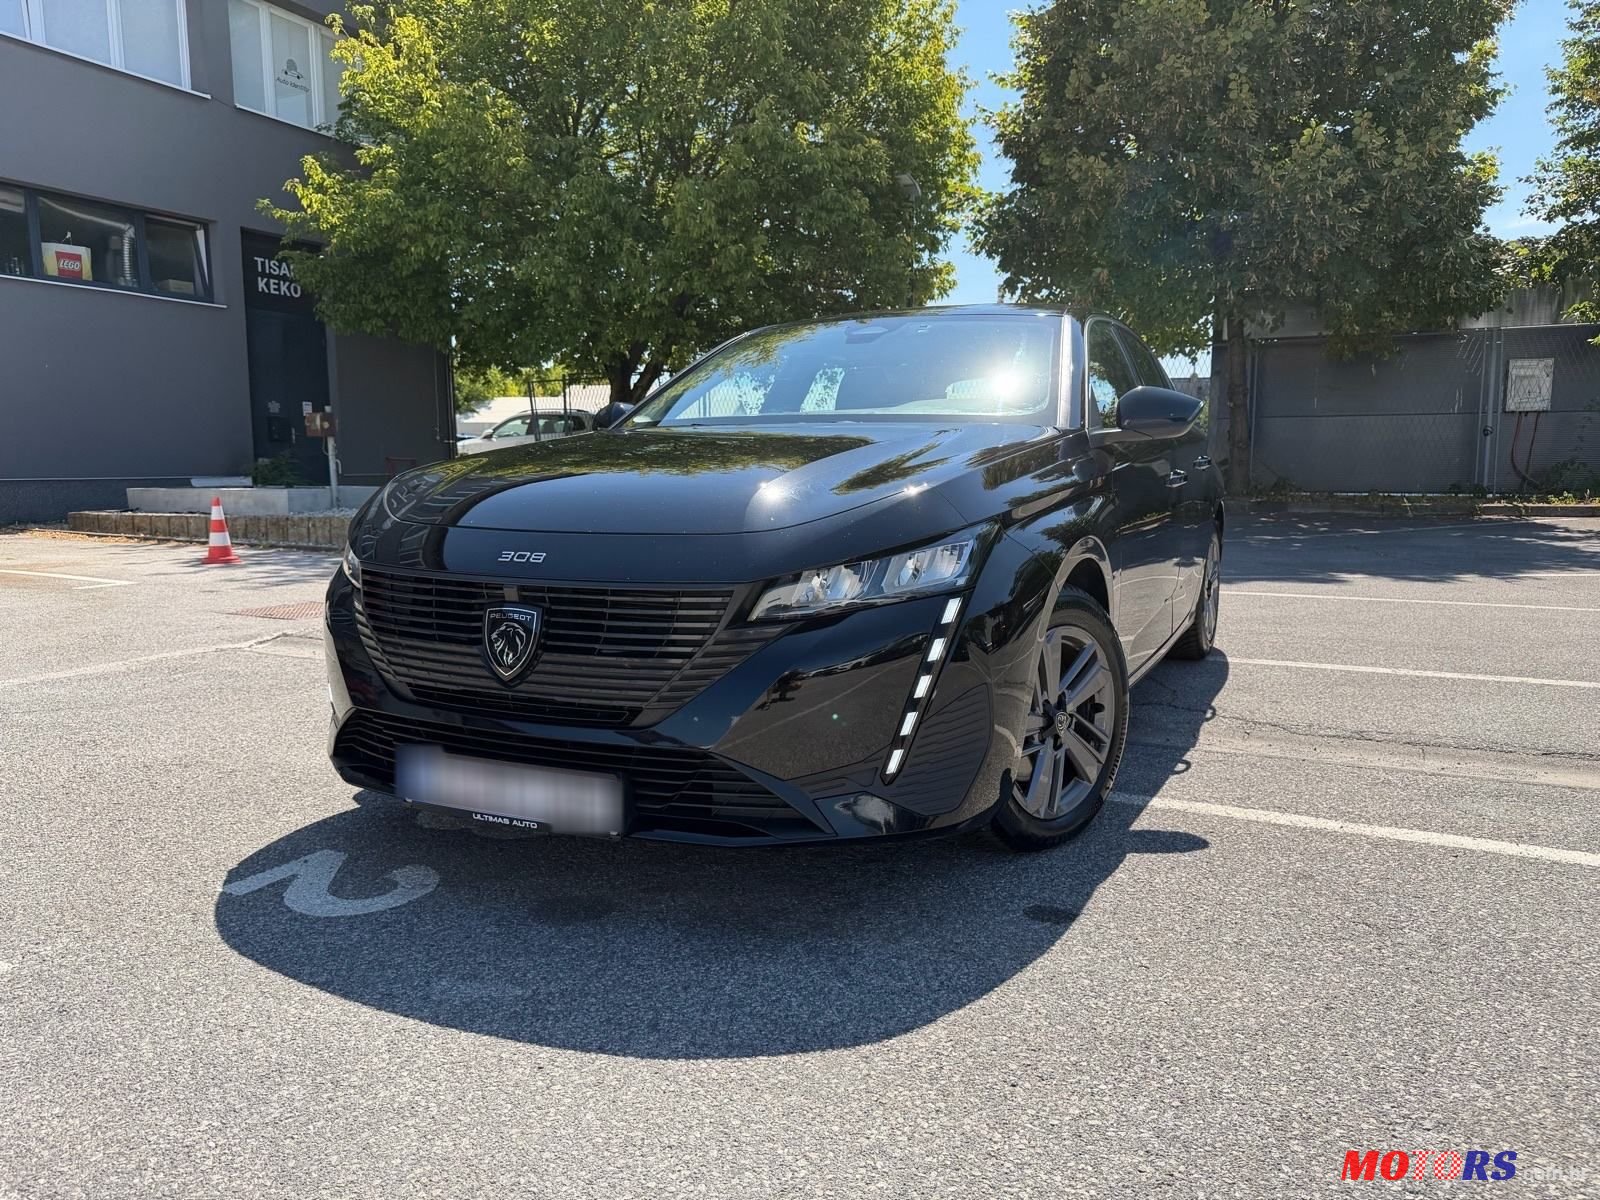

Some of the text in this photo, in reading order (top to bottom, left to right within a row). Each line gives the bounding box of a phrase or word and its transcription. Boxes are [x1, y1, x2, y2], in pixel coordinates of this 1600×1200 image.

[58, 259, 80, 271] LEGO
[257, 276, 301, 298] KEKO
[497, 551, 546, 563] 308
[489, 612, 533, 622] PEUGEOT
[472, 812, 538, 829] ULTIMAS AUTO
